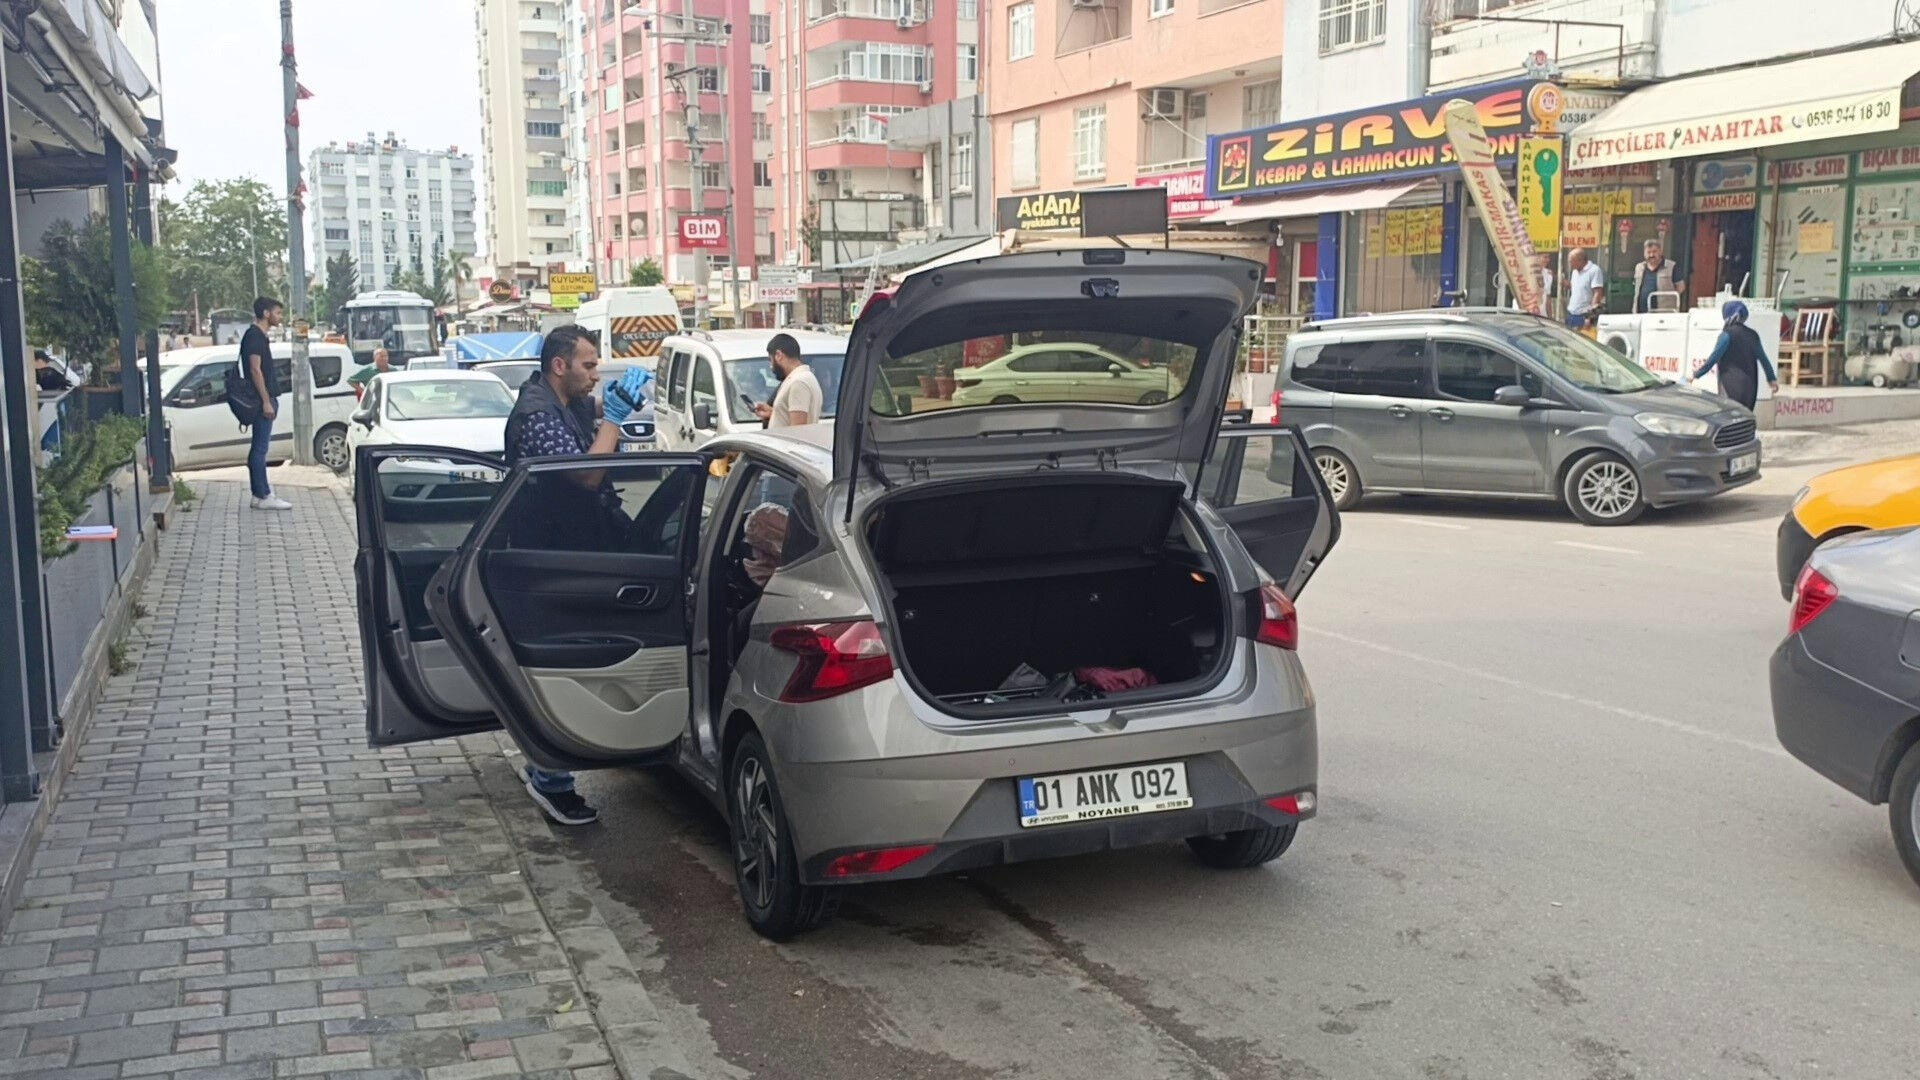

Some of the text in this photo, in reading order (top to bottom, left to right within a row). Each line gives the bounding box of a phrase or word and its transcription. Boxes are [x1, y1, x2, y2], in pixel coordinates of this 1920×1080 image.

[1577, 101, 1891, 164] ÇİFTÇİLER ANAHTAR 0536 944 18 30
[1255, 134, 1517, 186] KEBAP & LAHMACUN SON
[551, 275, 594, 284] KUYUMCU
[1034, 767, 1177, 811] 01 ANK 092
[1024, 800, 1035, 809] TR
[1078, 805, 1140, 818] NOYANER
